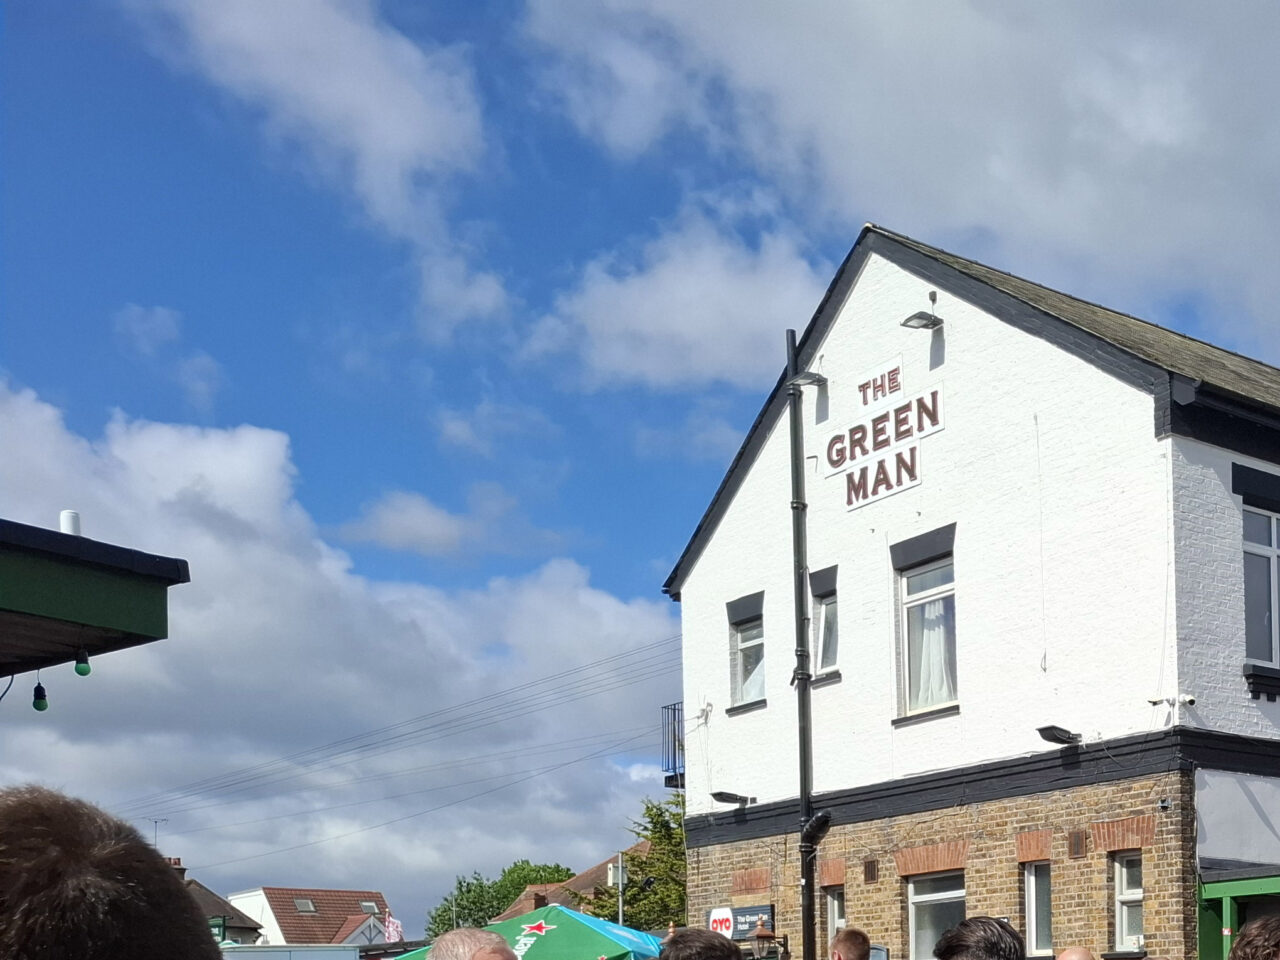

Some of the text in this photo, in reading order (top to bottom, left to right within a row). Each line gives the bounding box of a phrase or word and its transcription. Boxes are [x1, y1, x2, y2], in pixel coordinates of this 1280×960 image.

[858, 366, 901, 406] THE
[826, 390, 940, 468] GREEN
[846, 446, 918, 506] MAN
[711, 917, 731, 932] OYO
